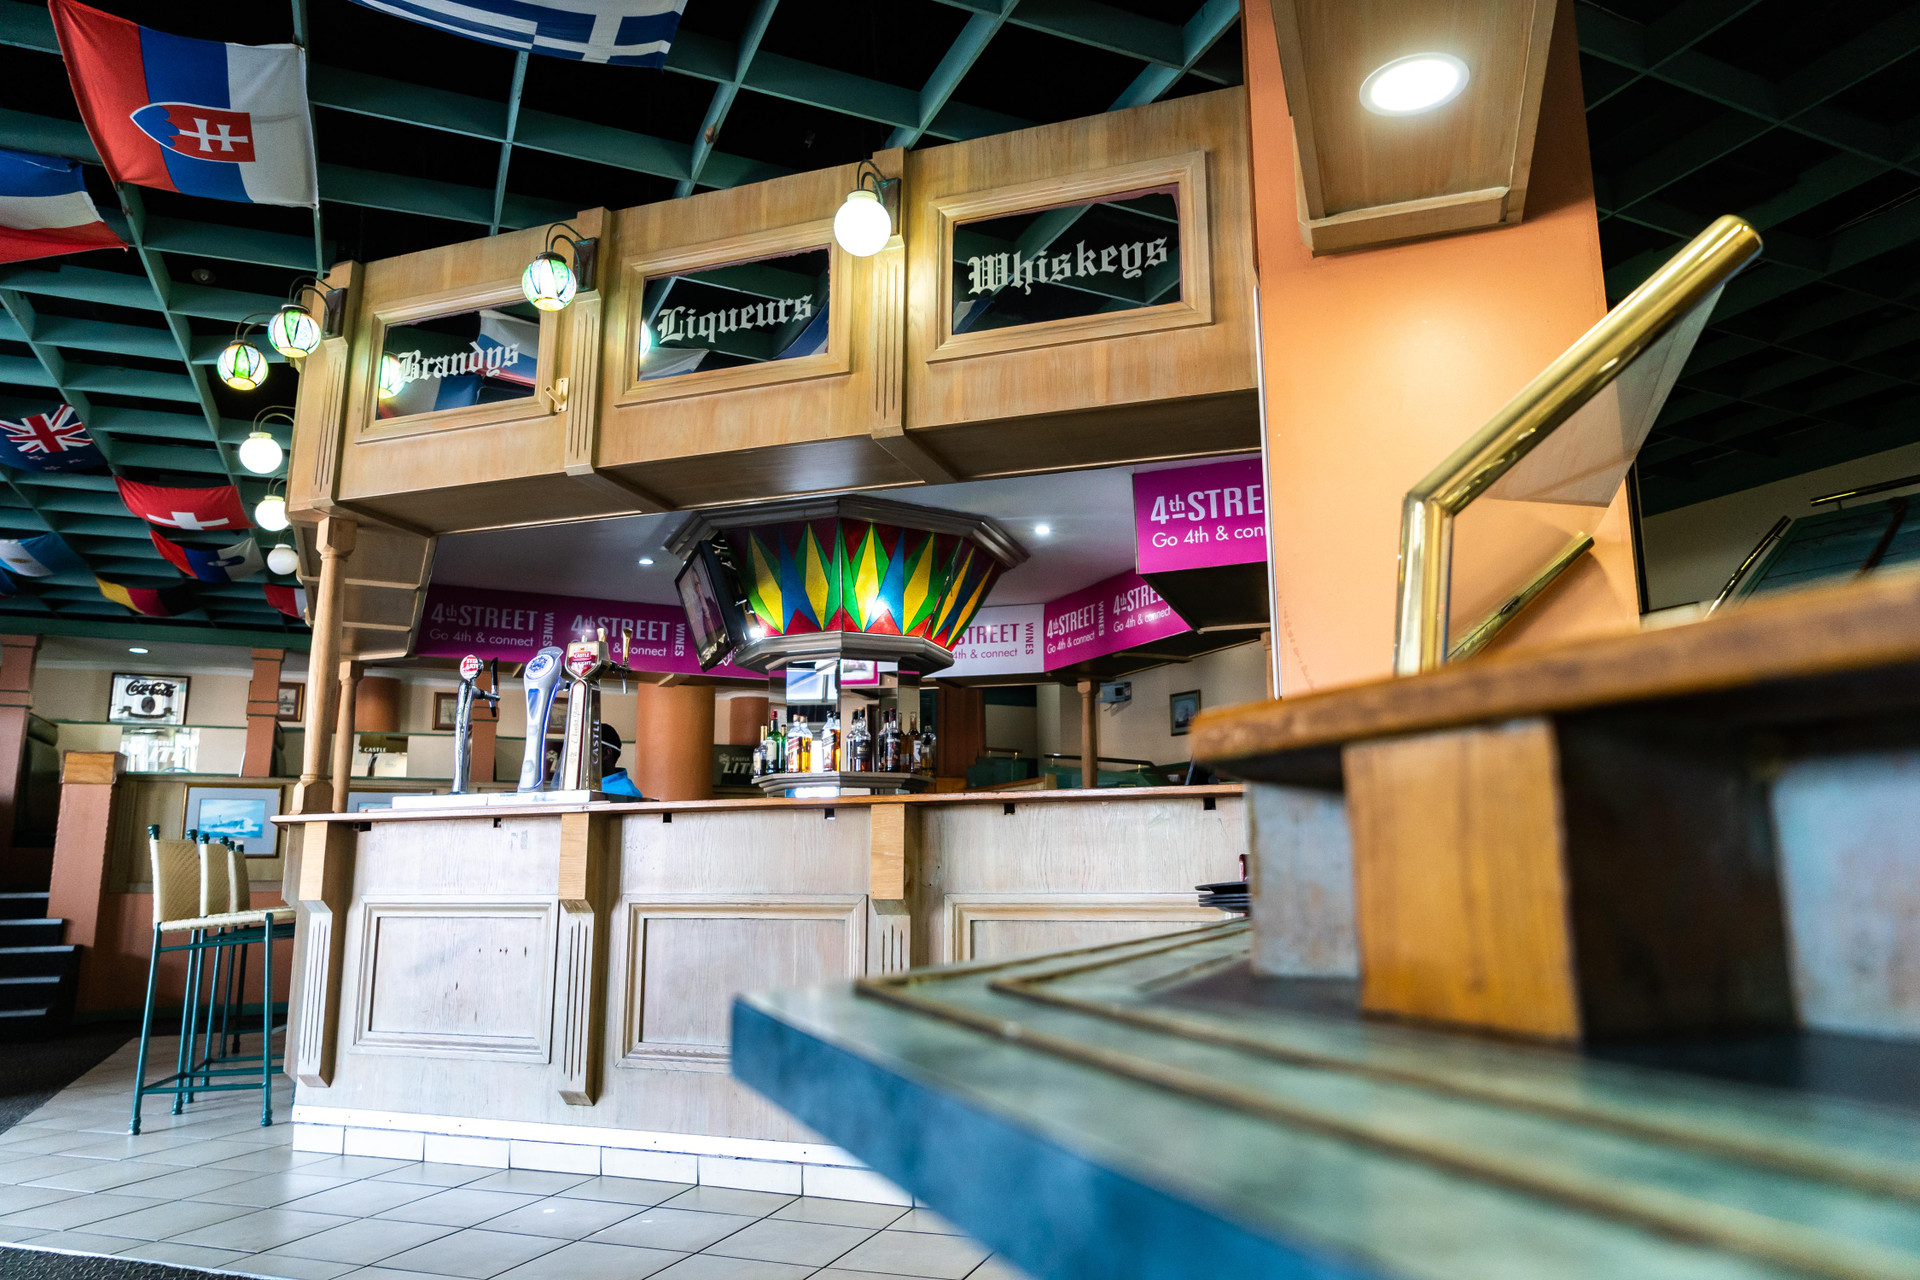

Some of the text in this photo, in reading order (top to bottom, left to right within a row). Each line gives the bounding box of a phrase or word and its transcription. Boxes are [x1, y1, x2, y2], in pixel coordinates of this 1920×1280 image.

[967, 236, 1168, 295] Whiskeys
[658, 293, 812, 343] Liqueurs
[398, 341, 520, 384] Brandys
[1152, 525, 1267, 548] Go 4th & con
[543, 612, 554, 647] WINES
[1113, 605, 1171, 632] Go 4th & connect
[429, 628, 534, 647] Go 4th & connect
[612, 642, 622, 653] &
[675, 623, 685, 657] WINES
[1025, 622, 1034, 655] WINES
[1046, 630, 1095, 654] Go 4th & connect
[969, 648, 978, 659] &
[980, 647, 1018, 659] connect
[126, 680, 177, 698] Coca-Cola
